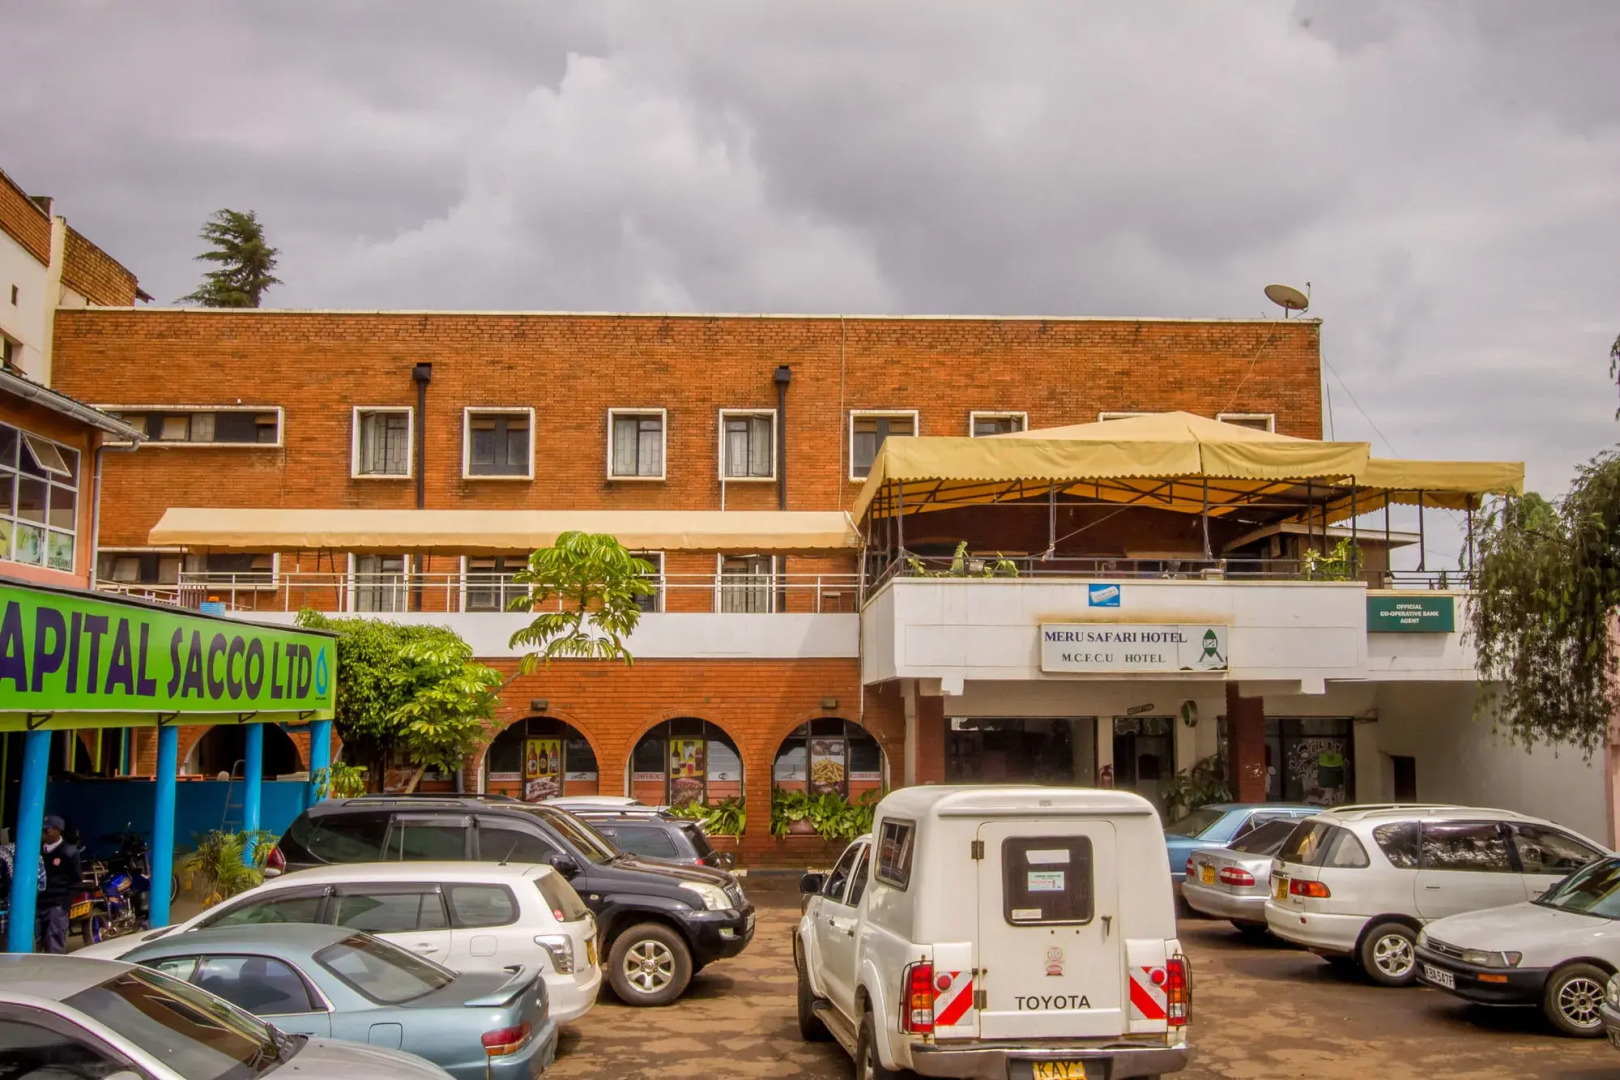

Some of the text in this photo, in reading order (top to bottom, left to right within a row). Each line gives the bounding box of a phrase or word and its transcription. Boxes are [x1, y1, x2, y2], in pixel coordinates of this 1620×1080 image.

[1044, 631, 1188, 643] MERU SAFARI HOTEL
[0, 601, 312, 700] APITAL SACCO LTD
[1125, 653, 1166, 663] HOTEL
[1014, 995, 1091, 1010] TOYOTA
[1036, 1060, 1071, 1077] KAY
